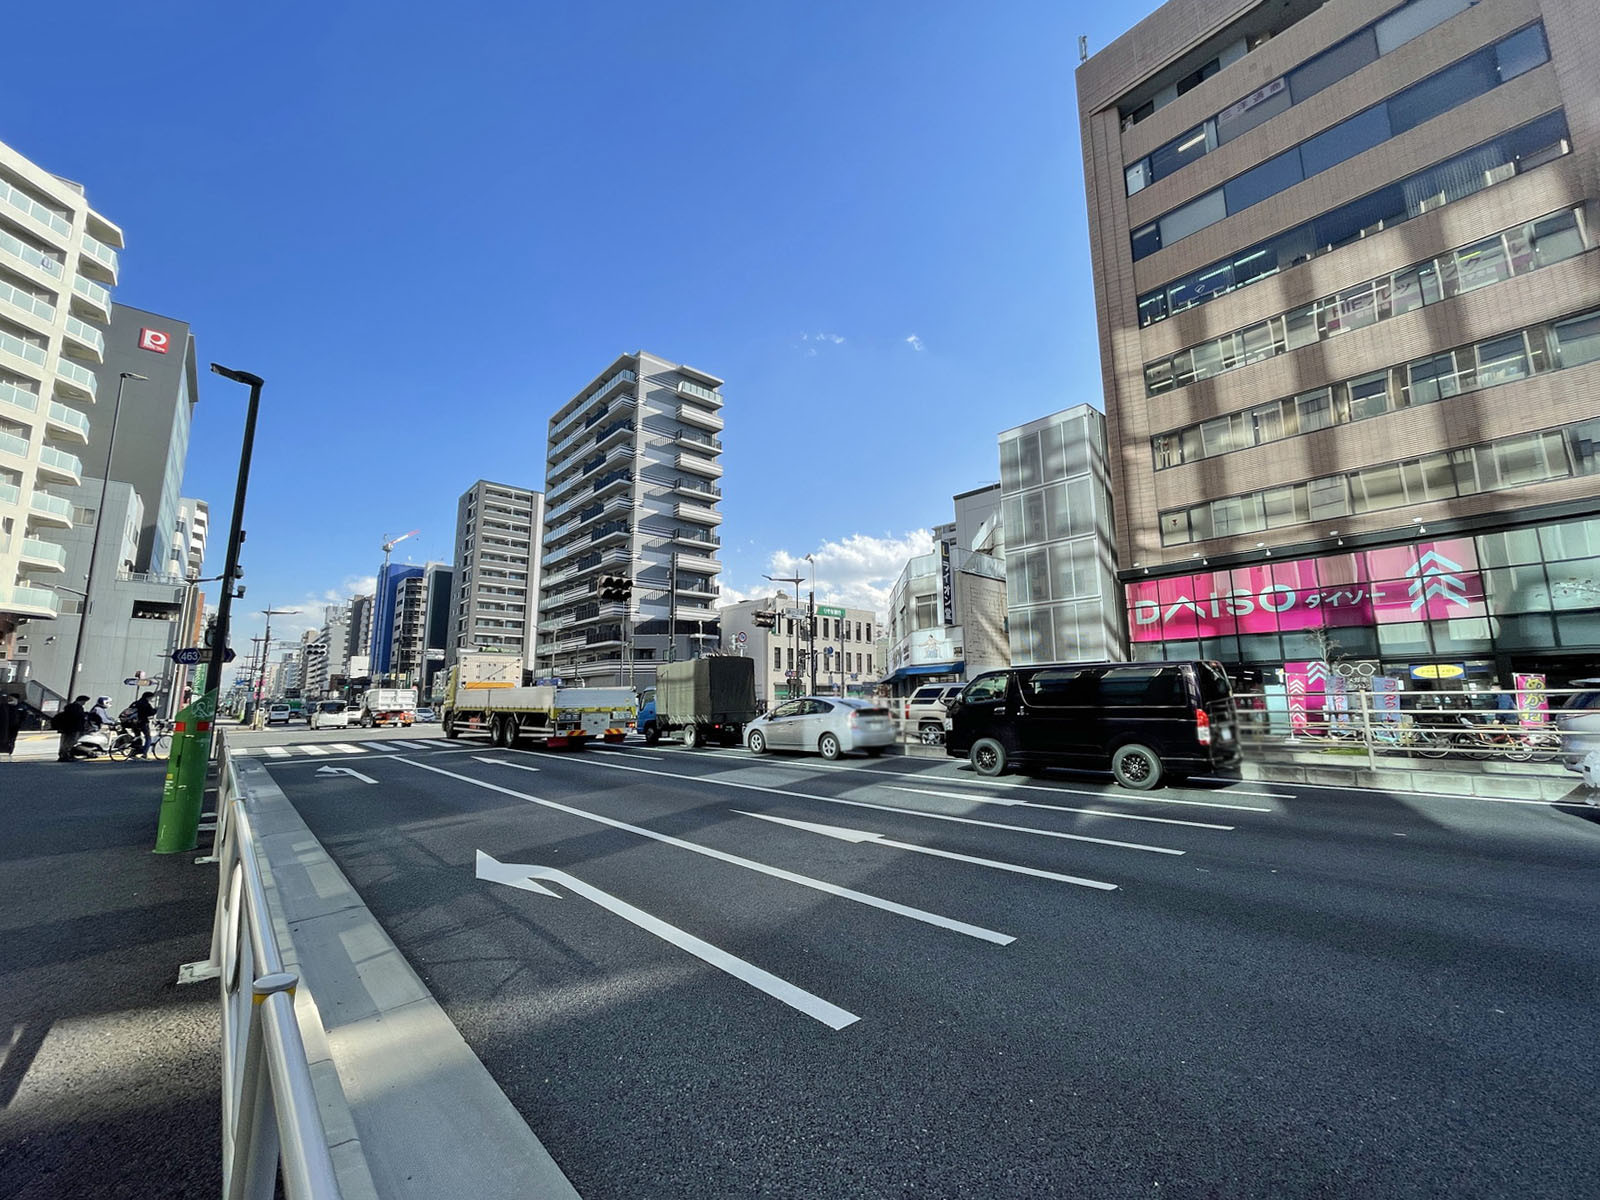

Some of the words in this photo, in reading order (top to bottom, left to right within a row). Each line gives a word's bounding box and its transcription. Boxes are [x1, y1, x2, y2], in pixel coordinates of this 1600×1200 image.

[1135, 584, 1296, 625] DAISO
[1305, 590, 1386, 609] ダイソー
[180, 651, 198, 661] 463
